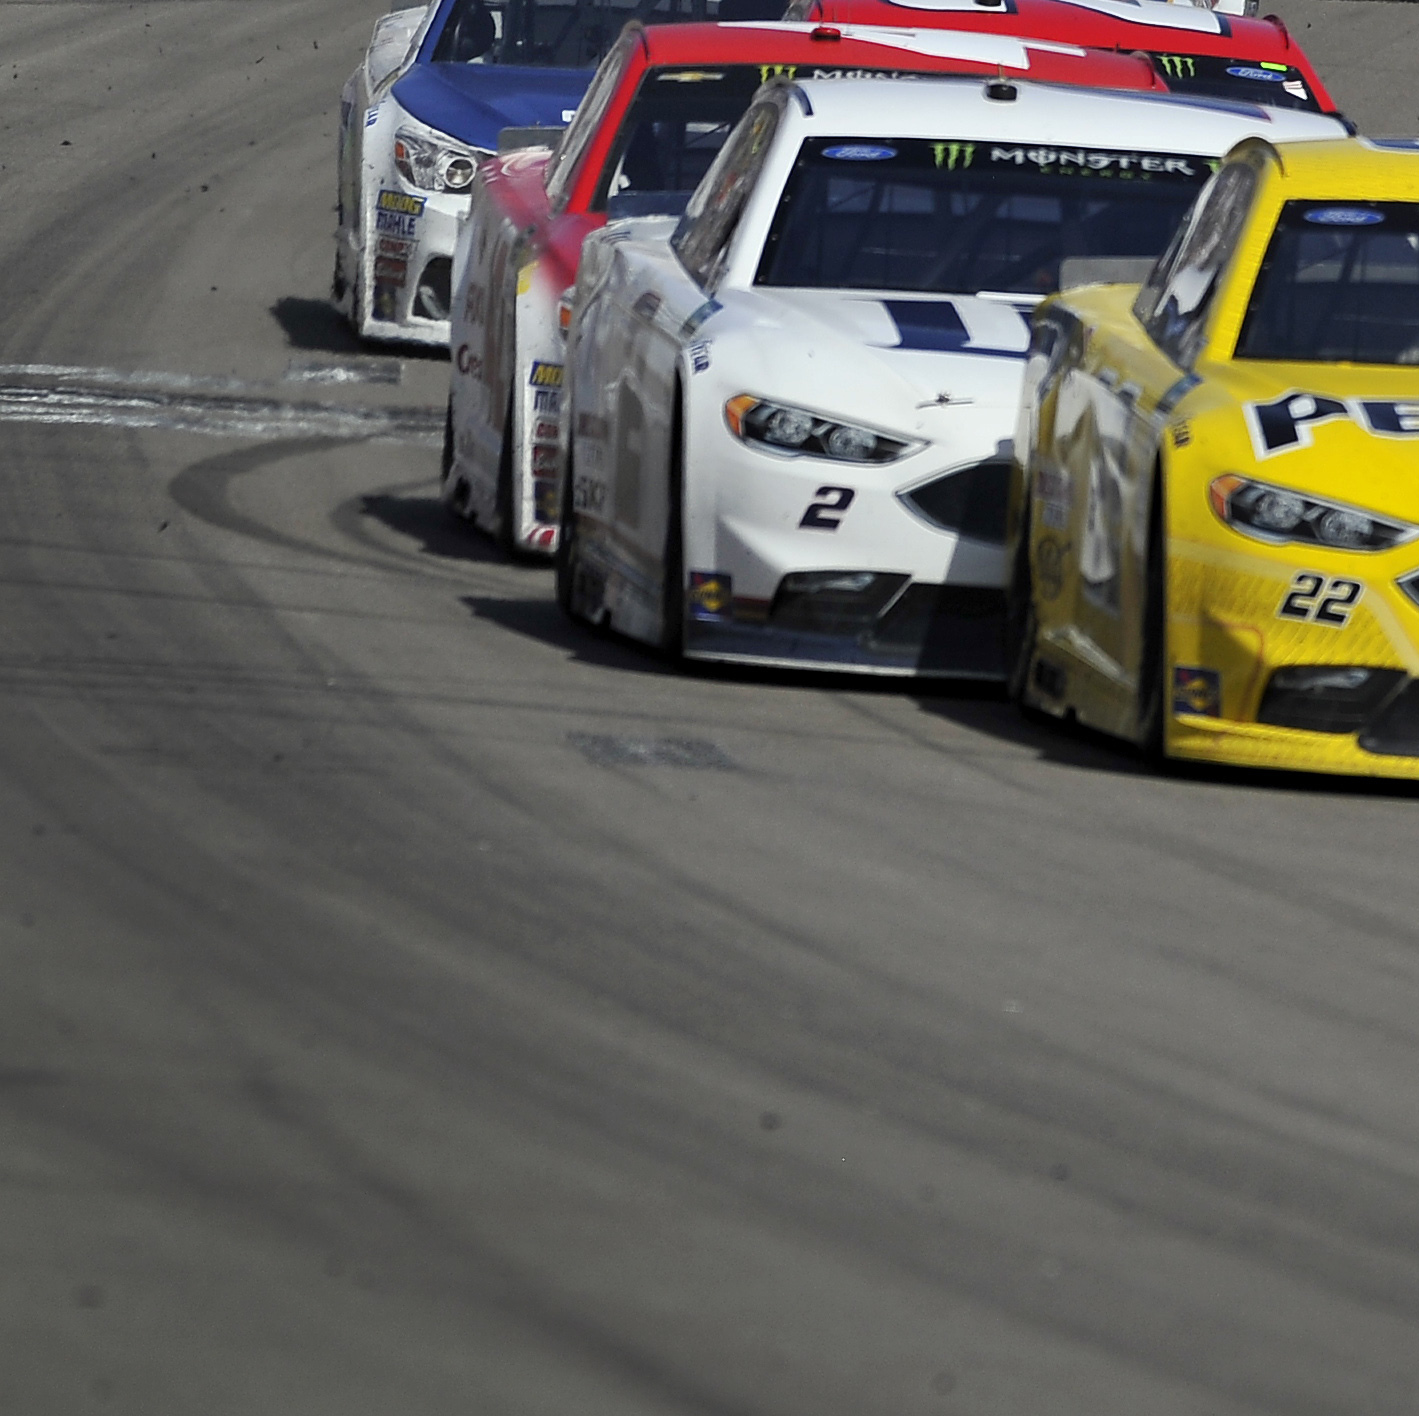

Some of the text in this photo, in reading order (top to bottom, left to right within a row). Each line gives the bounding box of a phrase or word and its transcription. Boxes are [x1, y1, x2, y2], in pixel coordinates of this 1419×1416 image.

[990, 146, 1196, 176] MONSTER
[380, 191, 425, 214] MOOG
[376, 212, 416, 235] MAHLE
[796, 485, 856, 531] 2
[1276, 570, 1366, 628] 22
